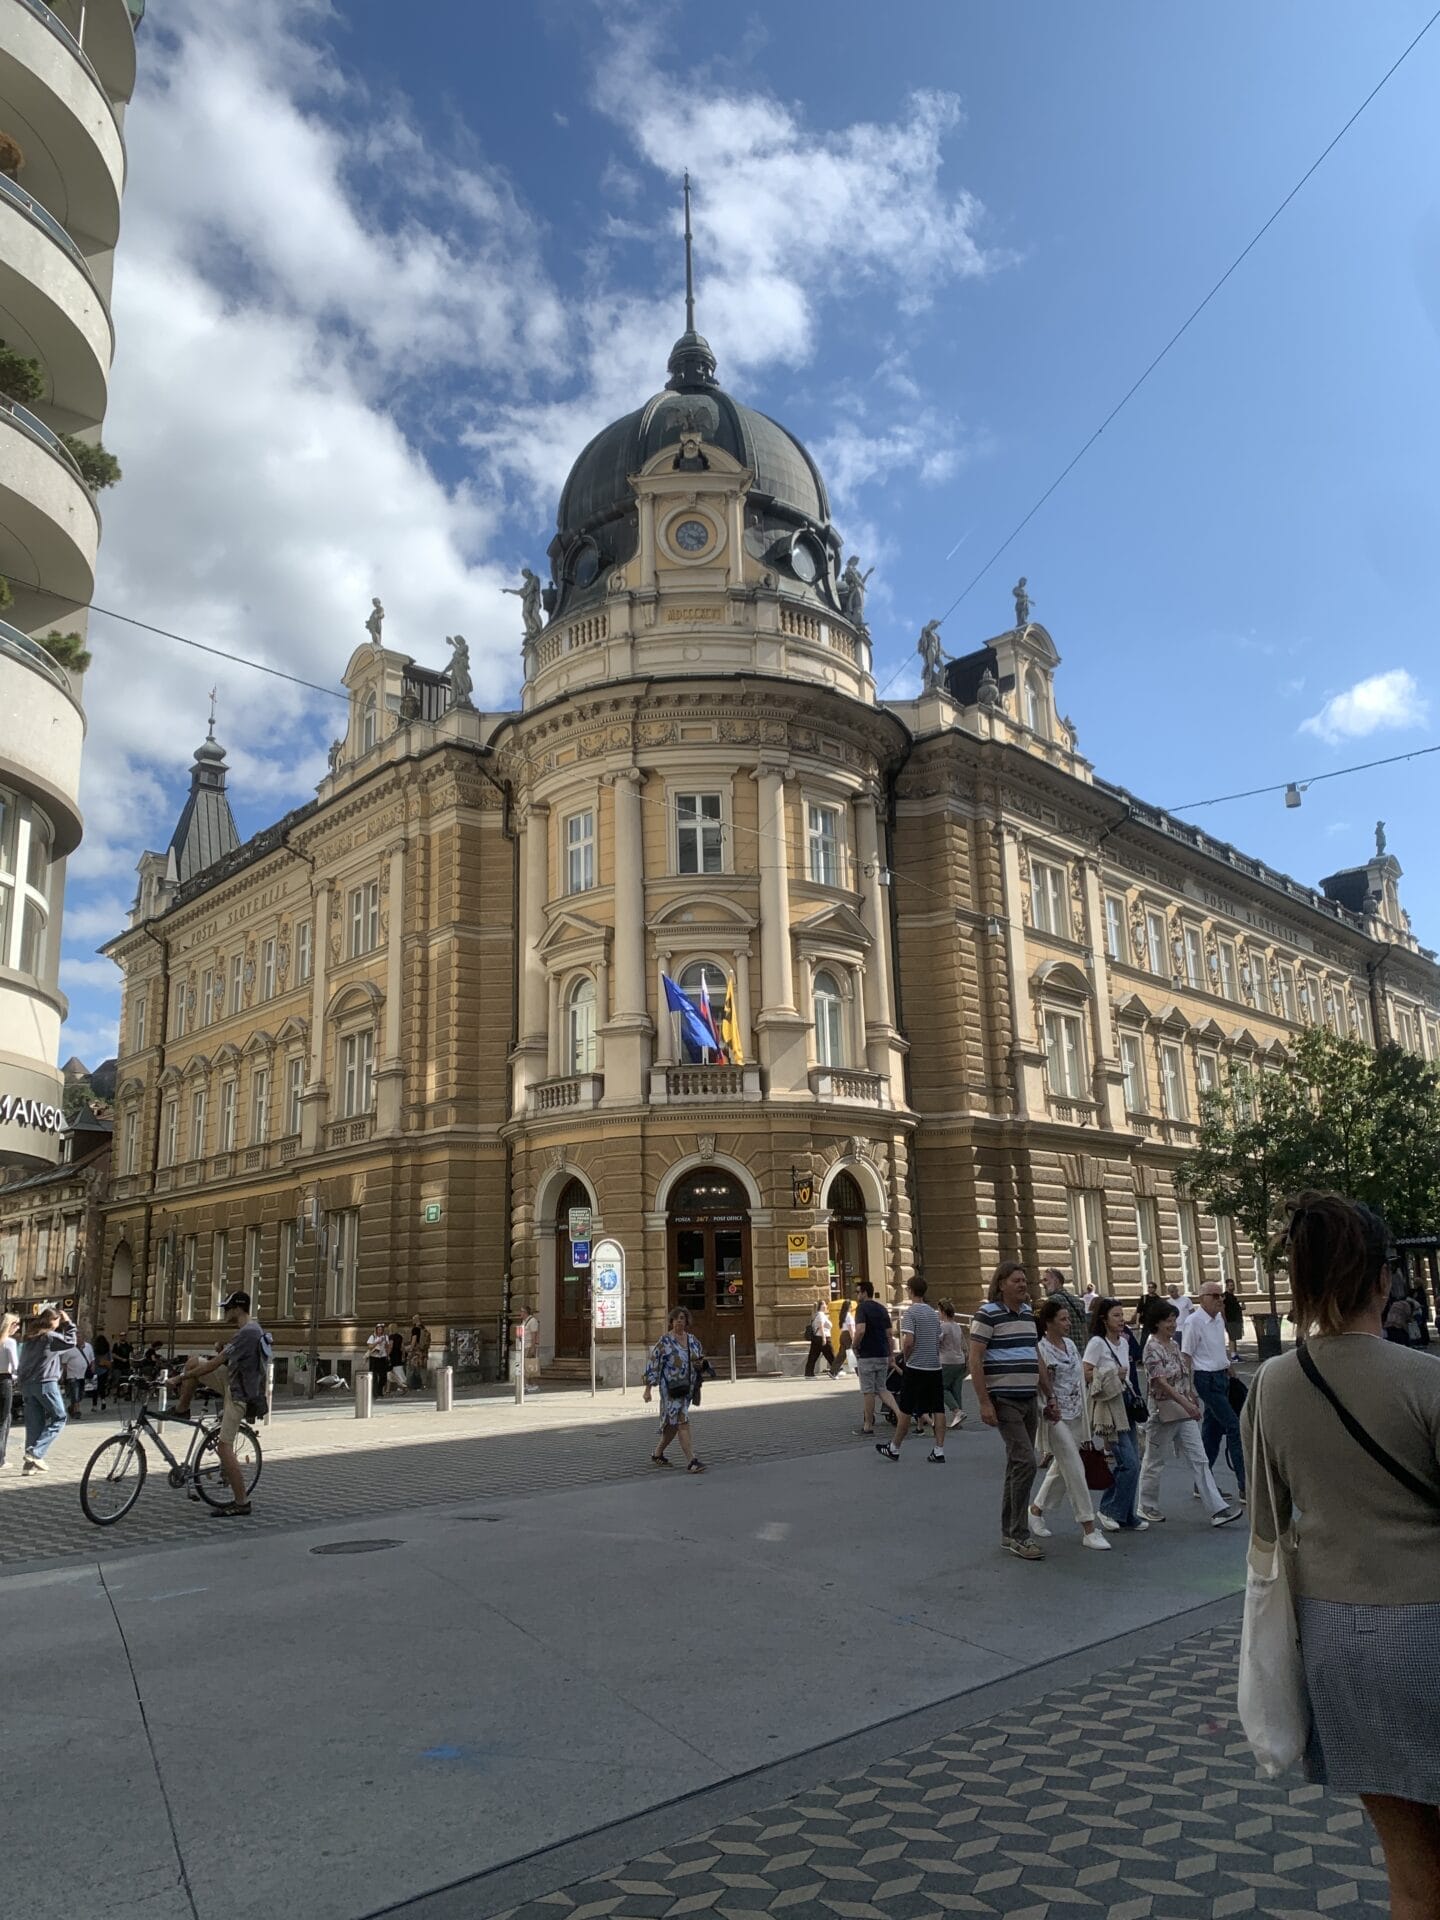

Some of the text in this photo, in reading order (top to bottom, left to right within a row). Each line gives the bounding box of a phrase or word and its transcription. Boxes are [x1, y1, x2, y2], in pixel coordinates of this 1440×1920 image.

[191, 881, 289, 946] POŠTA SLOVENIJE
[0, 1095, 61, 1131] MANGO
